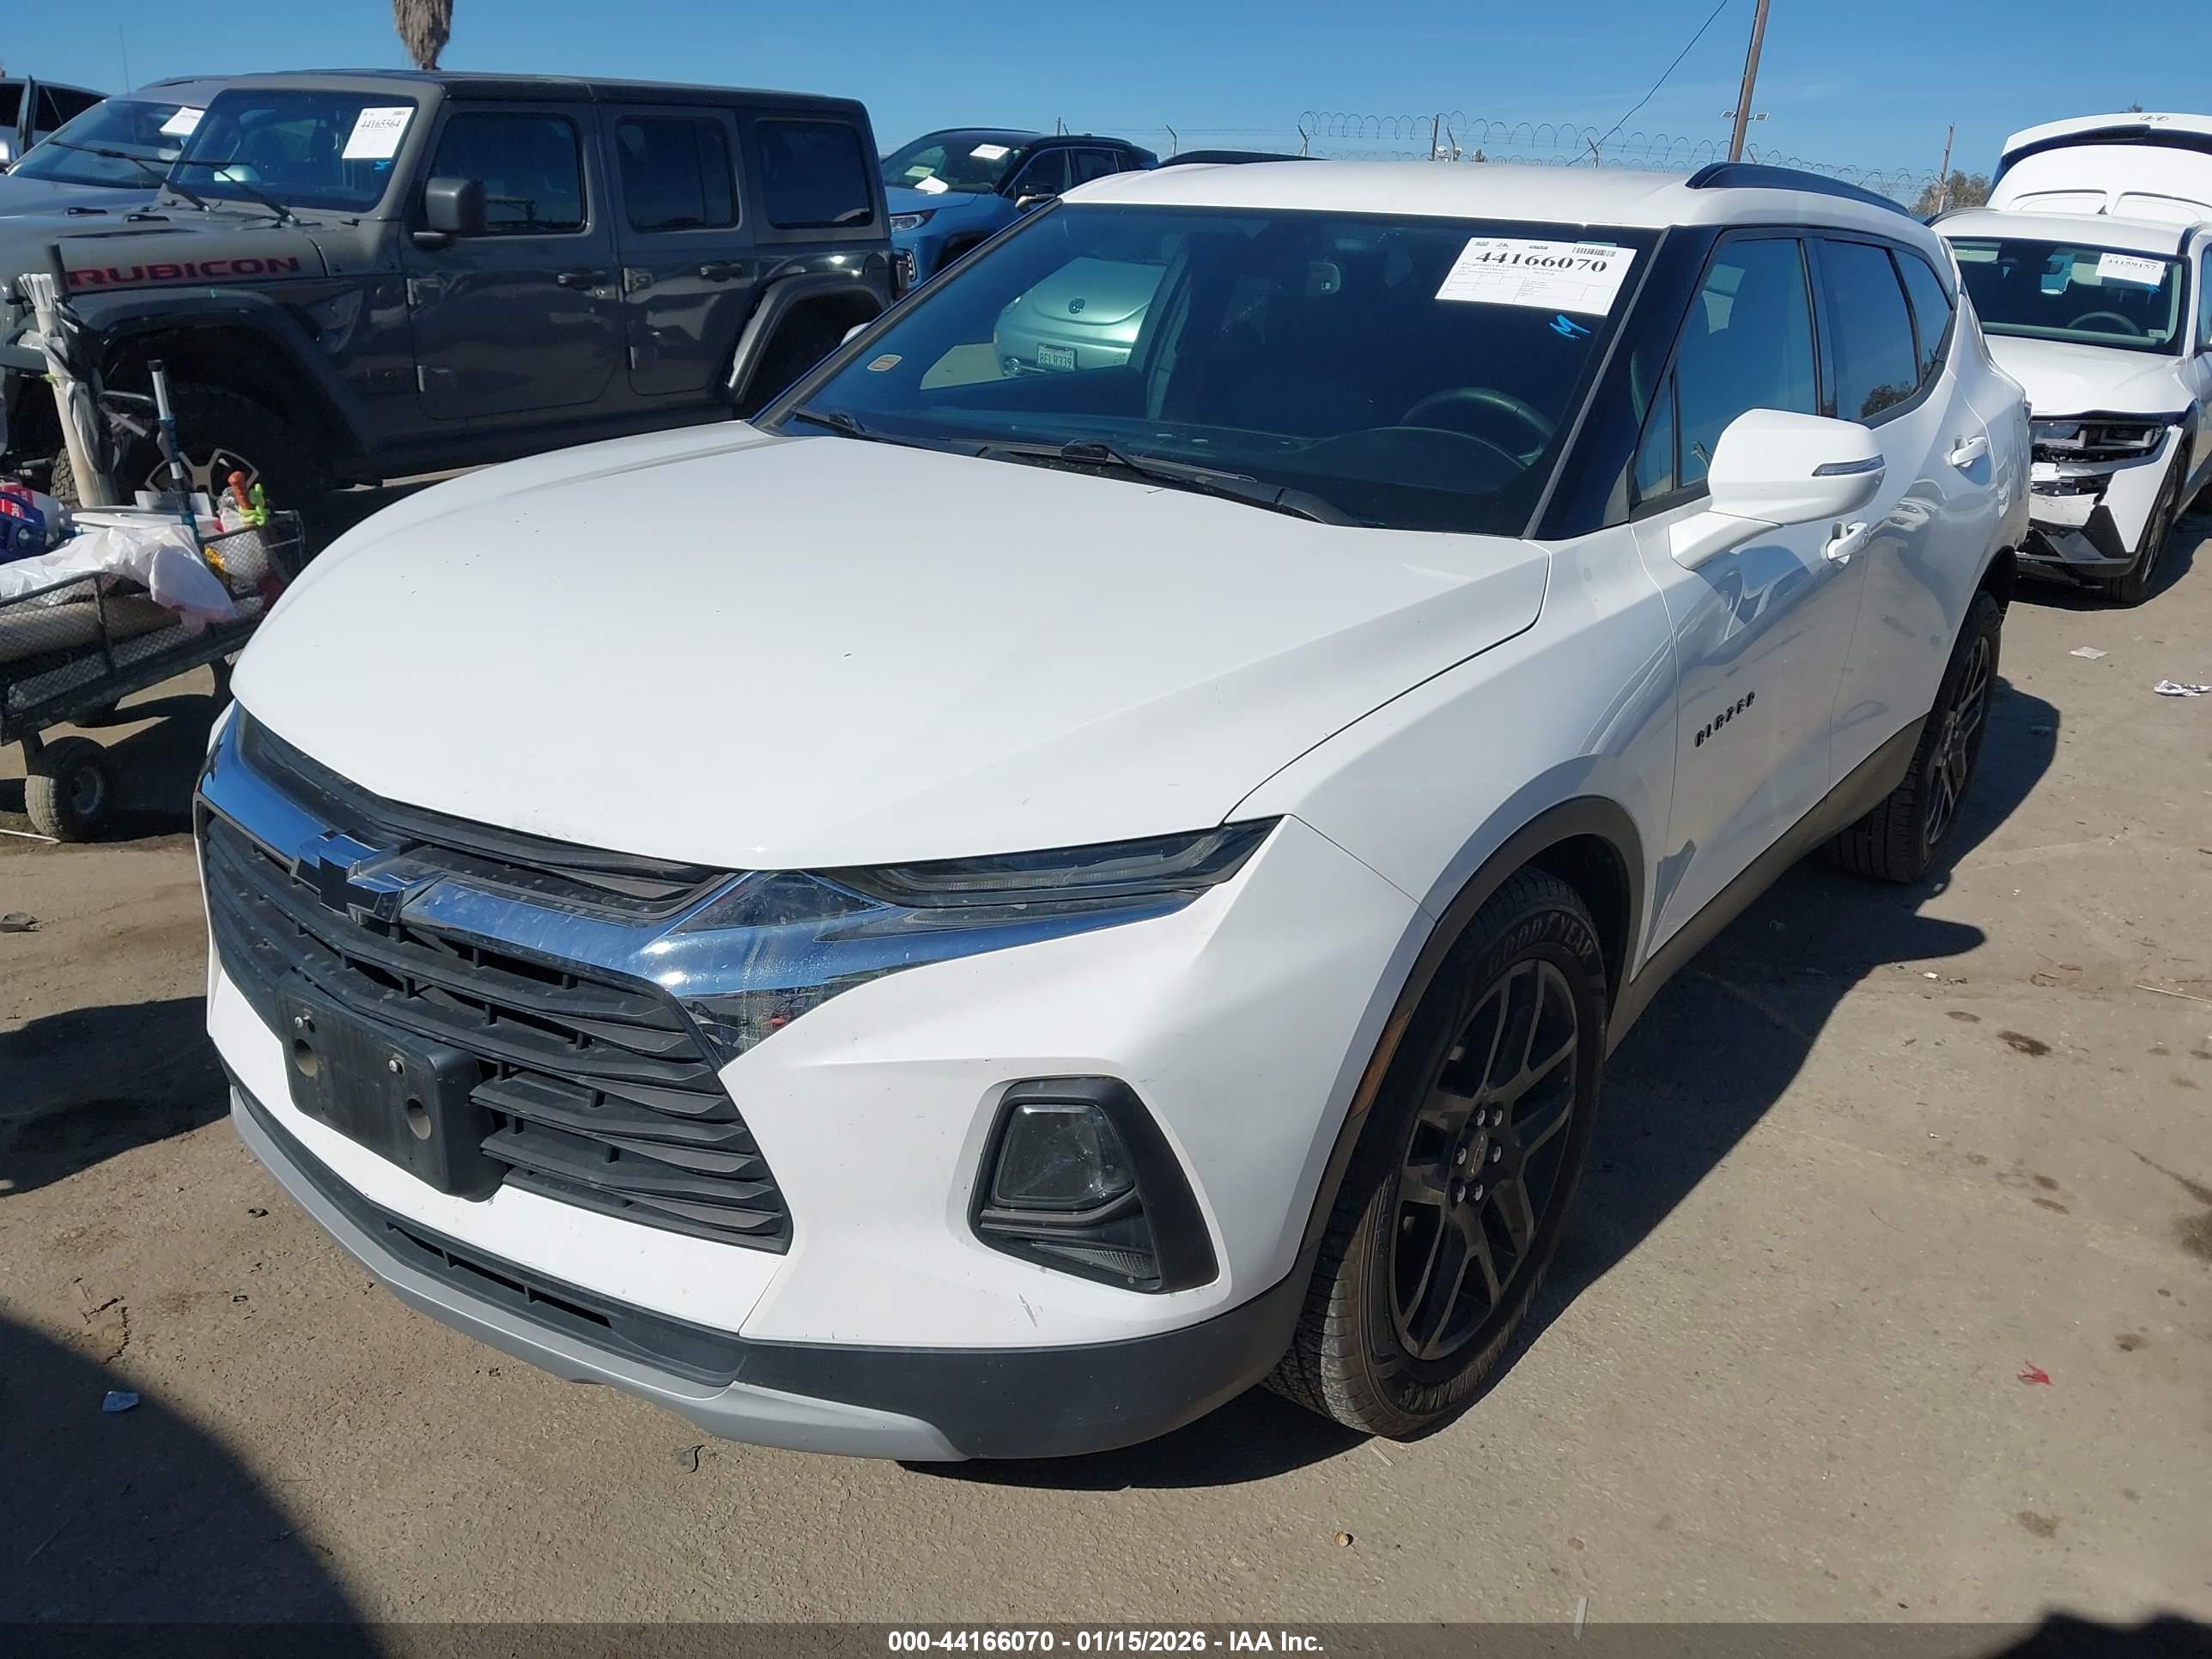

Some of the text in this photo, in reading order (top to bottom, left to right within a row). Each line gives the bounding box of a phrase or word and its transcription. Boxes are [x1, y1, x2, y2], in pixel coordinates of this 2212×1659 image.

[361, 119, 401, 129] 44165564
[67, 257, 298, 286] RUBICON
[1475, 252, 1607, 273] 44166070
[1694, 691, 1756, 748] BLAZER
